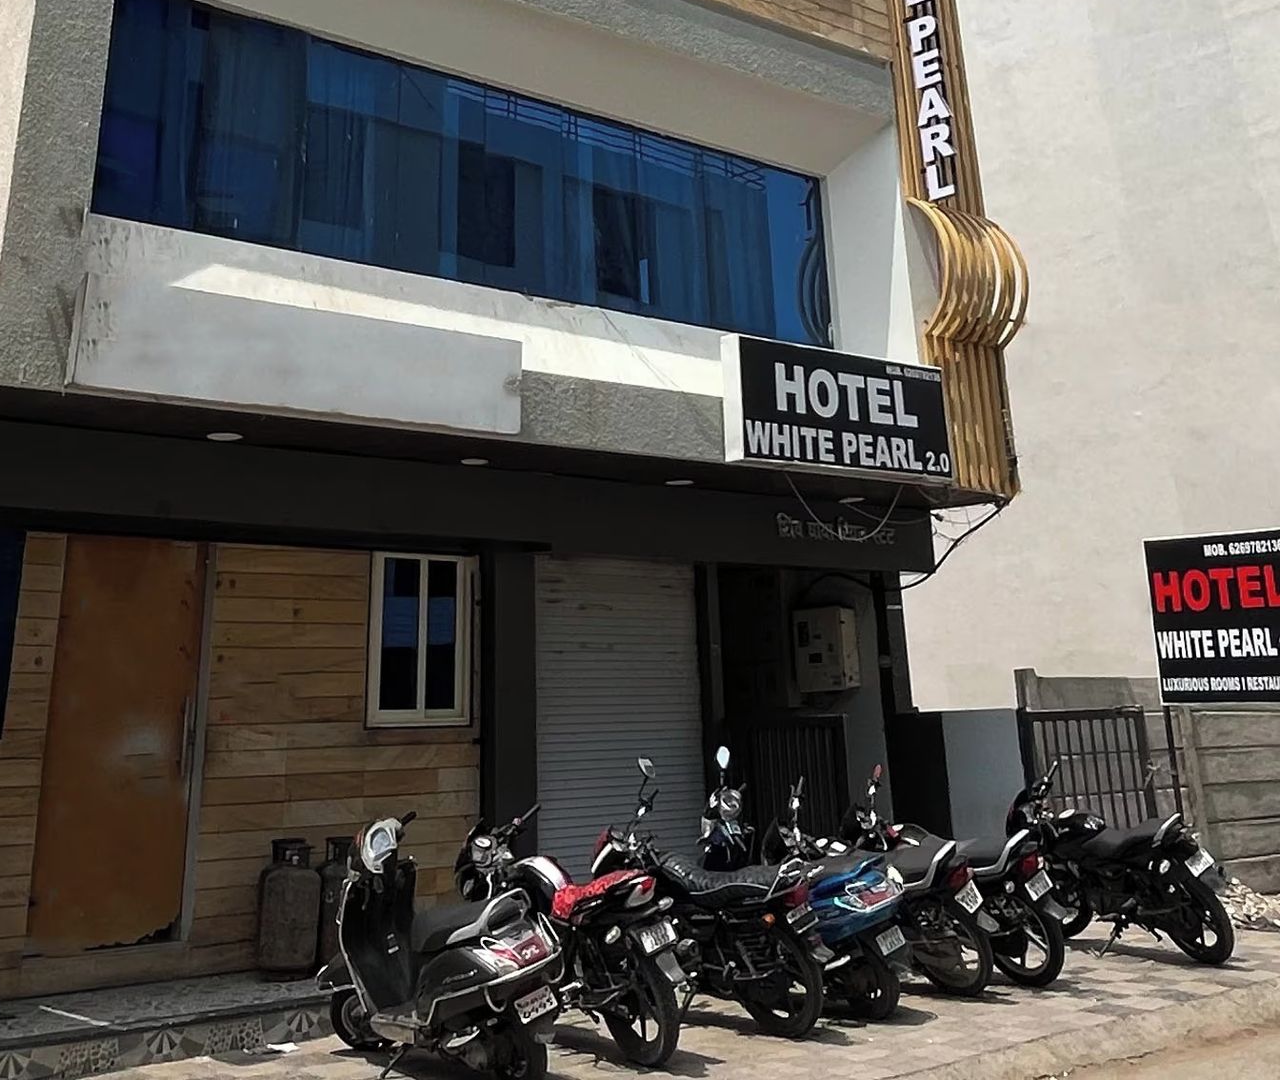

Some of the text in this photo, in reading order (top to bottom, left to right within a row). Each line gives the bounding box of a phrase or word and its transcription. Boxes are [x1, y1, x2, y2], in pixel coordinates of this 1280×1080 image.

[907, 15, 957, 201] PEARL
[774, 362, 919, 428] HOTEL
[745, 419, 950, 473] WHITE PEARL 2.0
[1203, 544, 1228, 557] MOB.
[1157, 630, 1215, 659] WHITE
[1217, 627, 1278, 657] PEARL
[1162, 677, 1209, 692] LUXURIOUS
[1210, 677, 1240, 691] ROOMS
